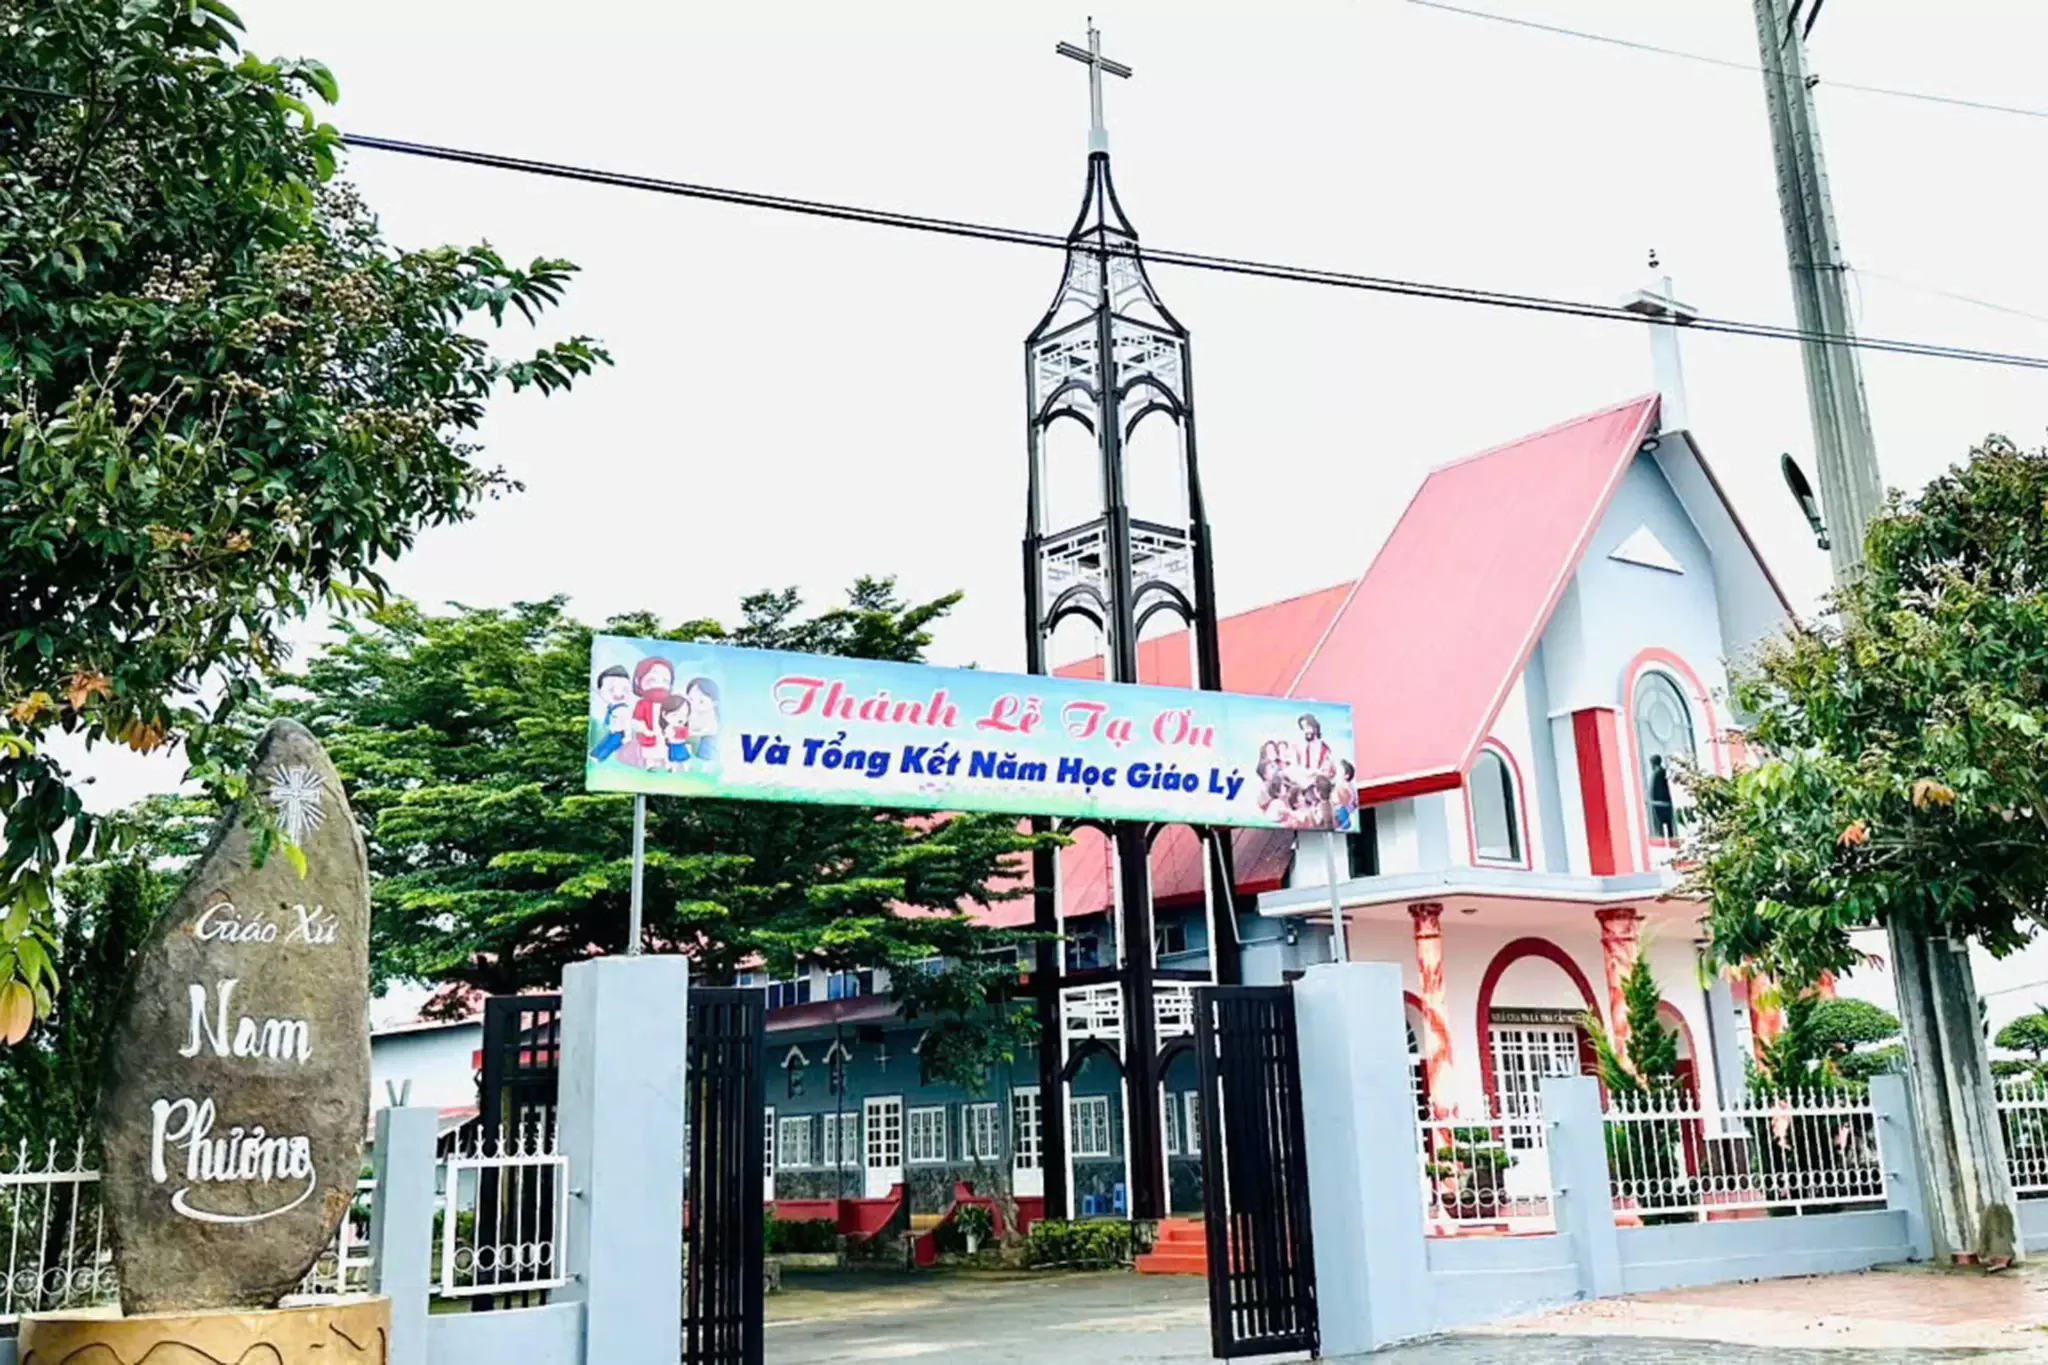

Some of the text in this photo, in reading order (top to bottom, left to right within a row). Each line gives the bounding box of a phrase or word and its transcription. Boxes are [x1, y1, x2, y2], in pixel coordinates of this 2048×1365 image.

[774, 676, 1214, 748] Thánh Lễ Tạ Ơn
[741, 731, 1244, 800] Và Tổng Kết Năm Học Giáo Lý
[195, 902, 278, 942] Giáo
[178, 978, 313, 1065] Nam
[151, 1097, 316, 1222] Phương
